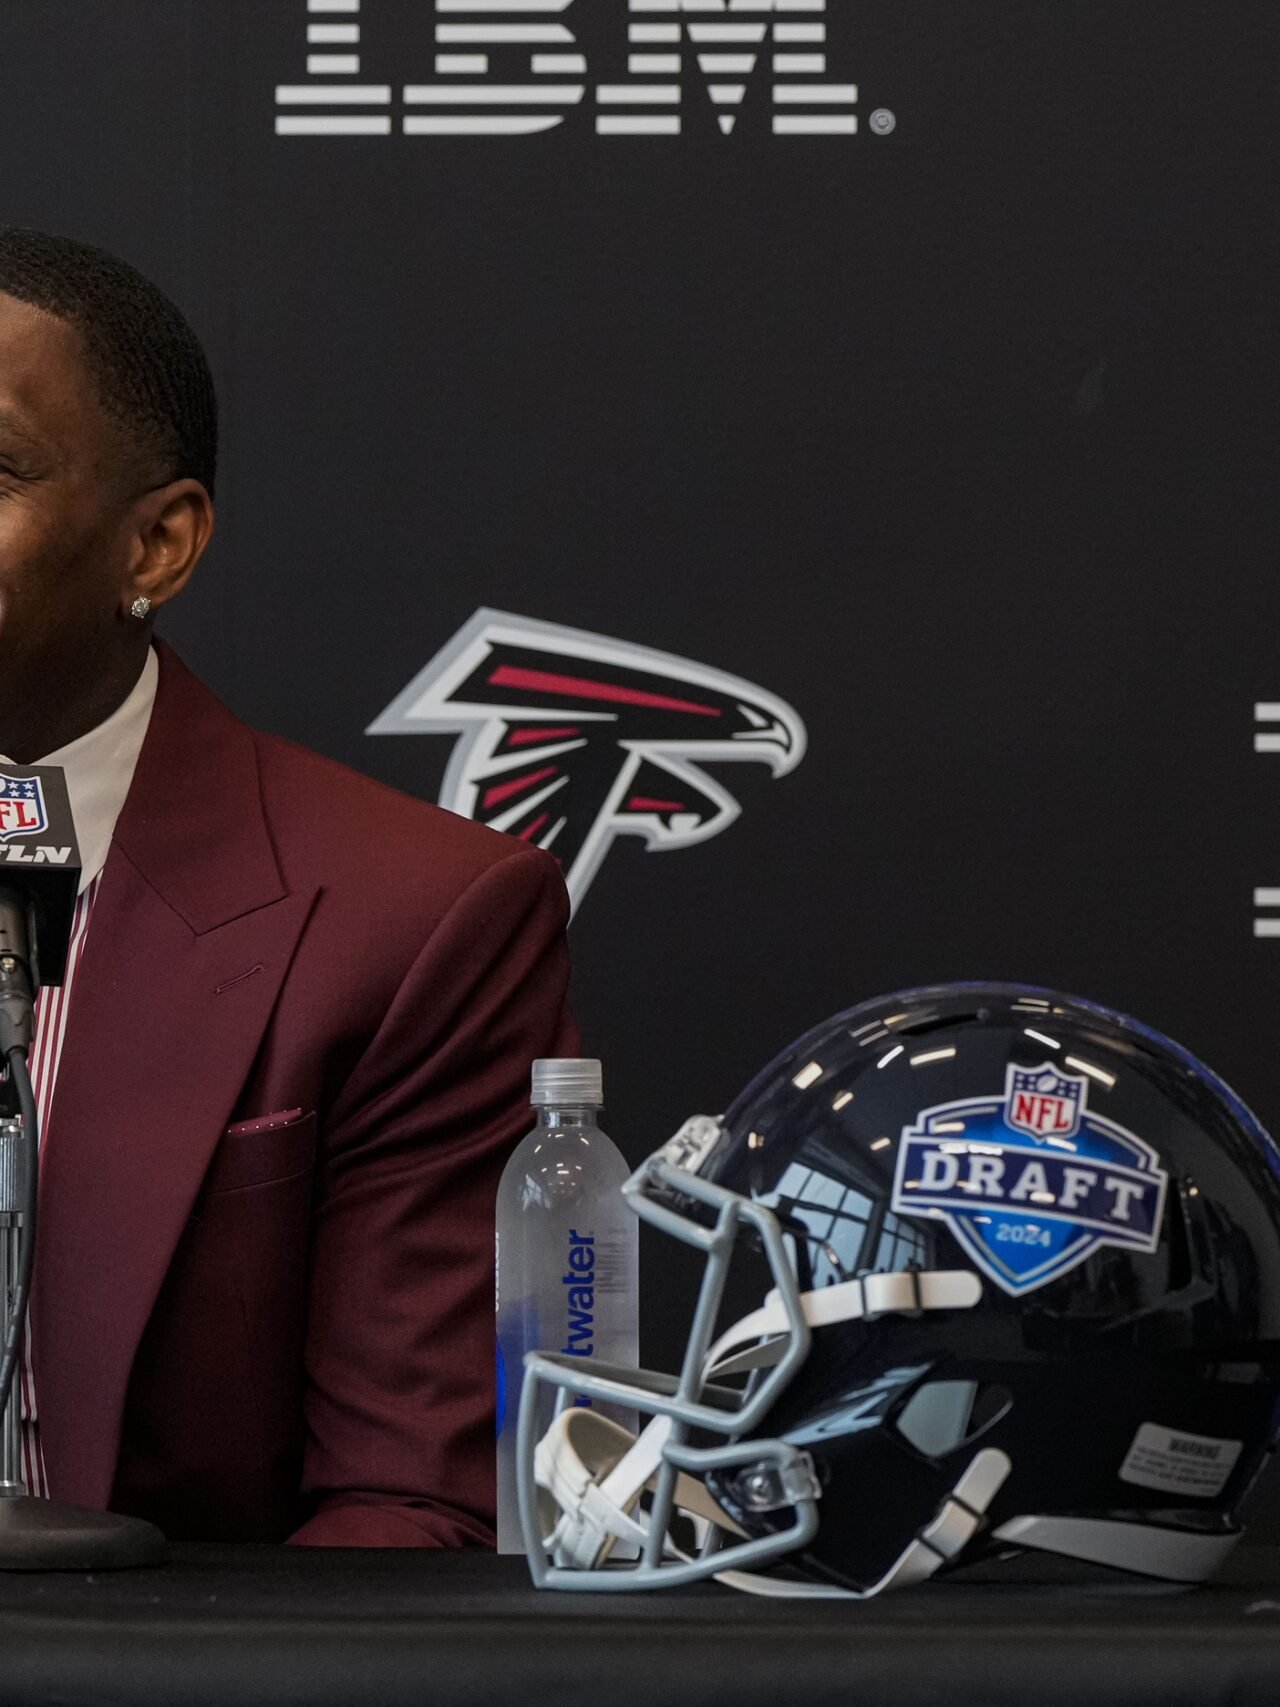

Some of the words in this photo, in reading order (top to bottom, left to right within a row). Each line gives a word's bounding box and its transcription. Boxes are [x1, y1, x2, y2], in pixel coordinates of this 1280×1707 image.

[1015, 1093, 1070, 1131] NFL
[922, 1150, 1145, 1221] DRAFT
[995, 1223, 1052, 1248] 2024
